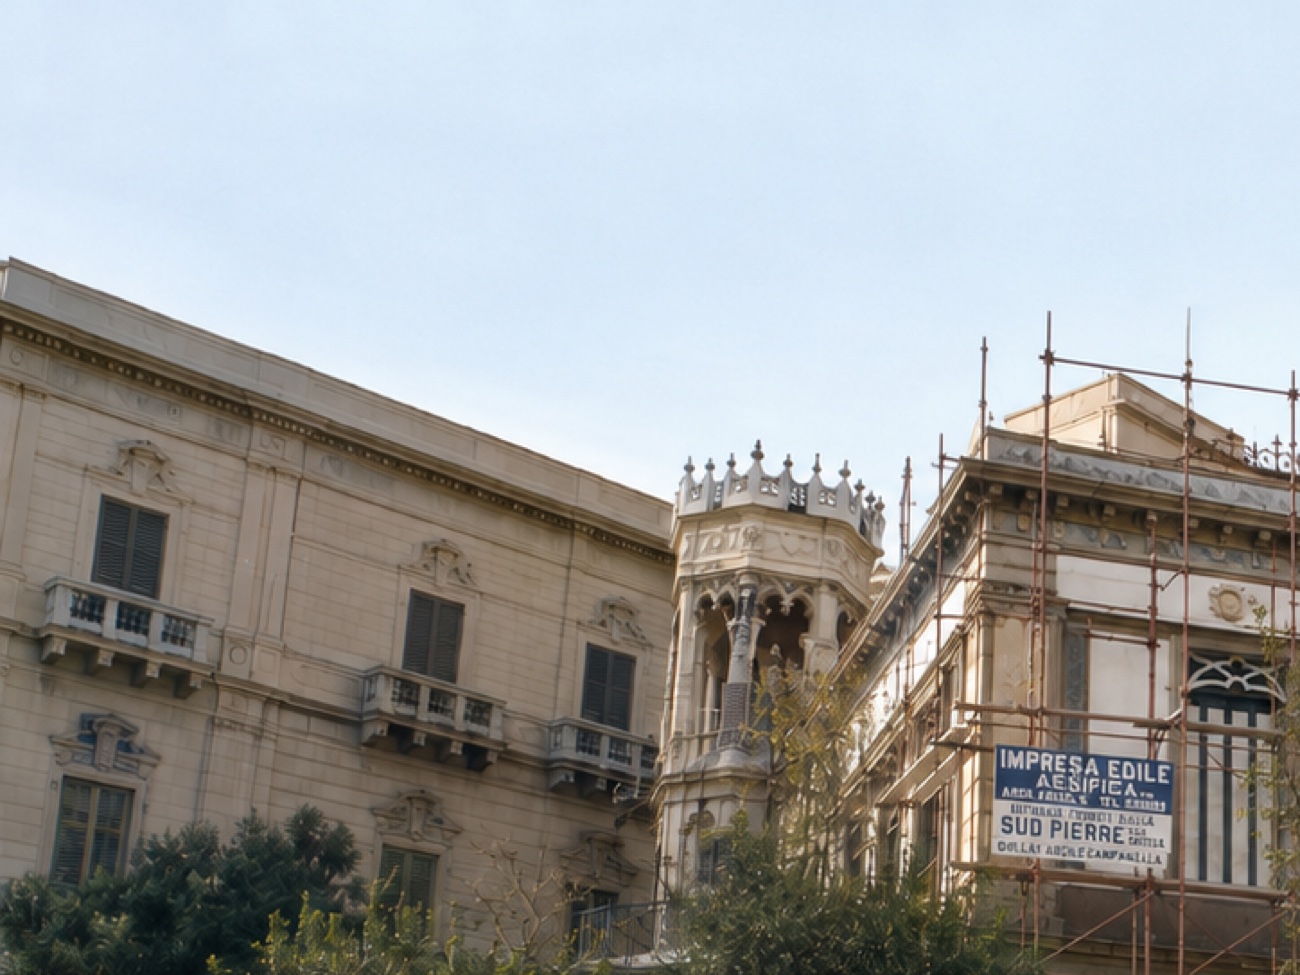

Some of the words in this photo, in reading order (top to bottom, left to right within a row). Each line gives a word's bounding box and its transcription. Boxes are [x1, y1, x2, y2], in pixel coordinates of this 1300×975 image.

[1001, 749, 1099, 777] IMPRESA
[1108, 759, 1171, 784] EDILE
[1001, 815, 1042, 836] SUD
[1050, 819, 1125, 845] PIERRE
